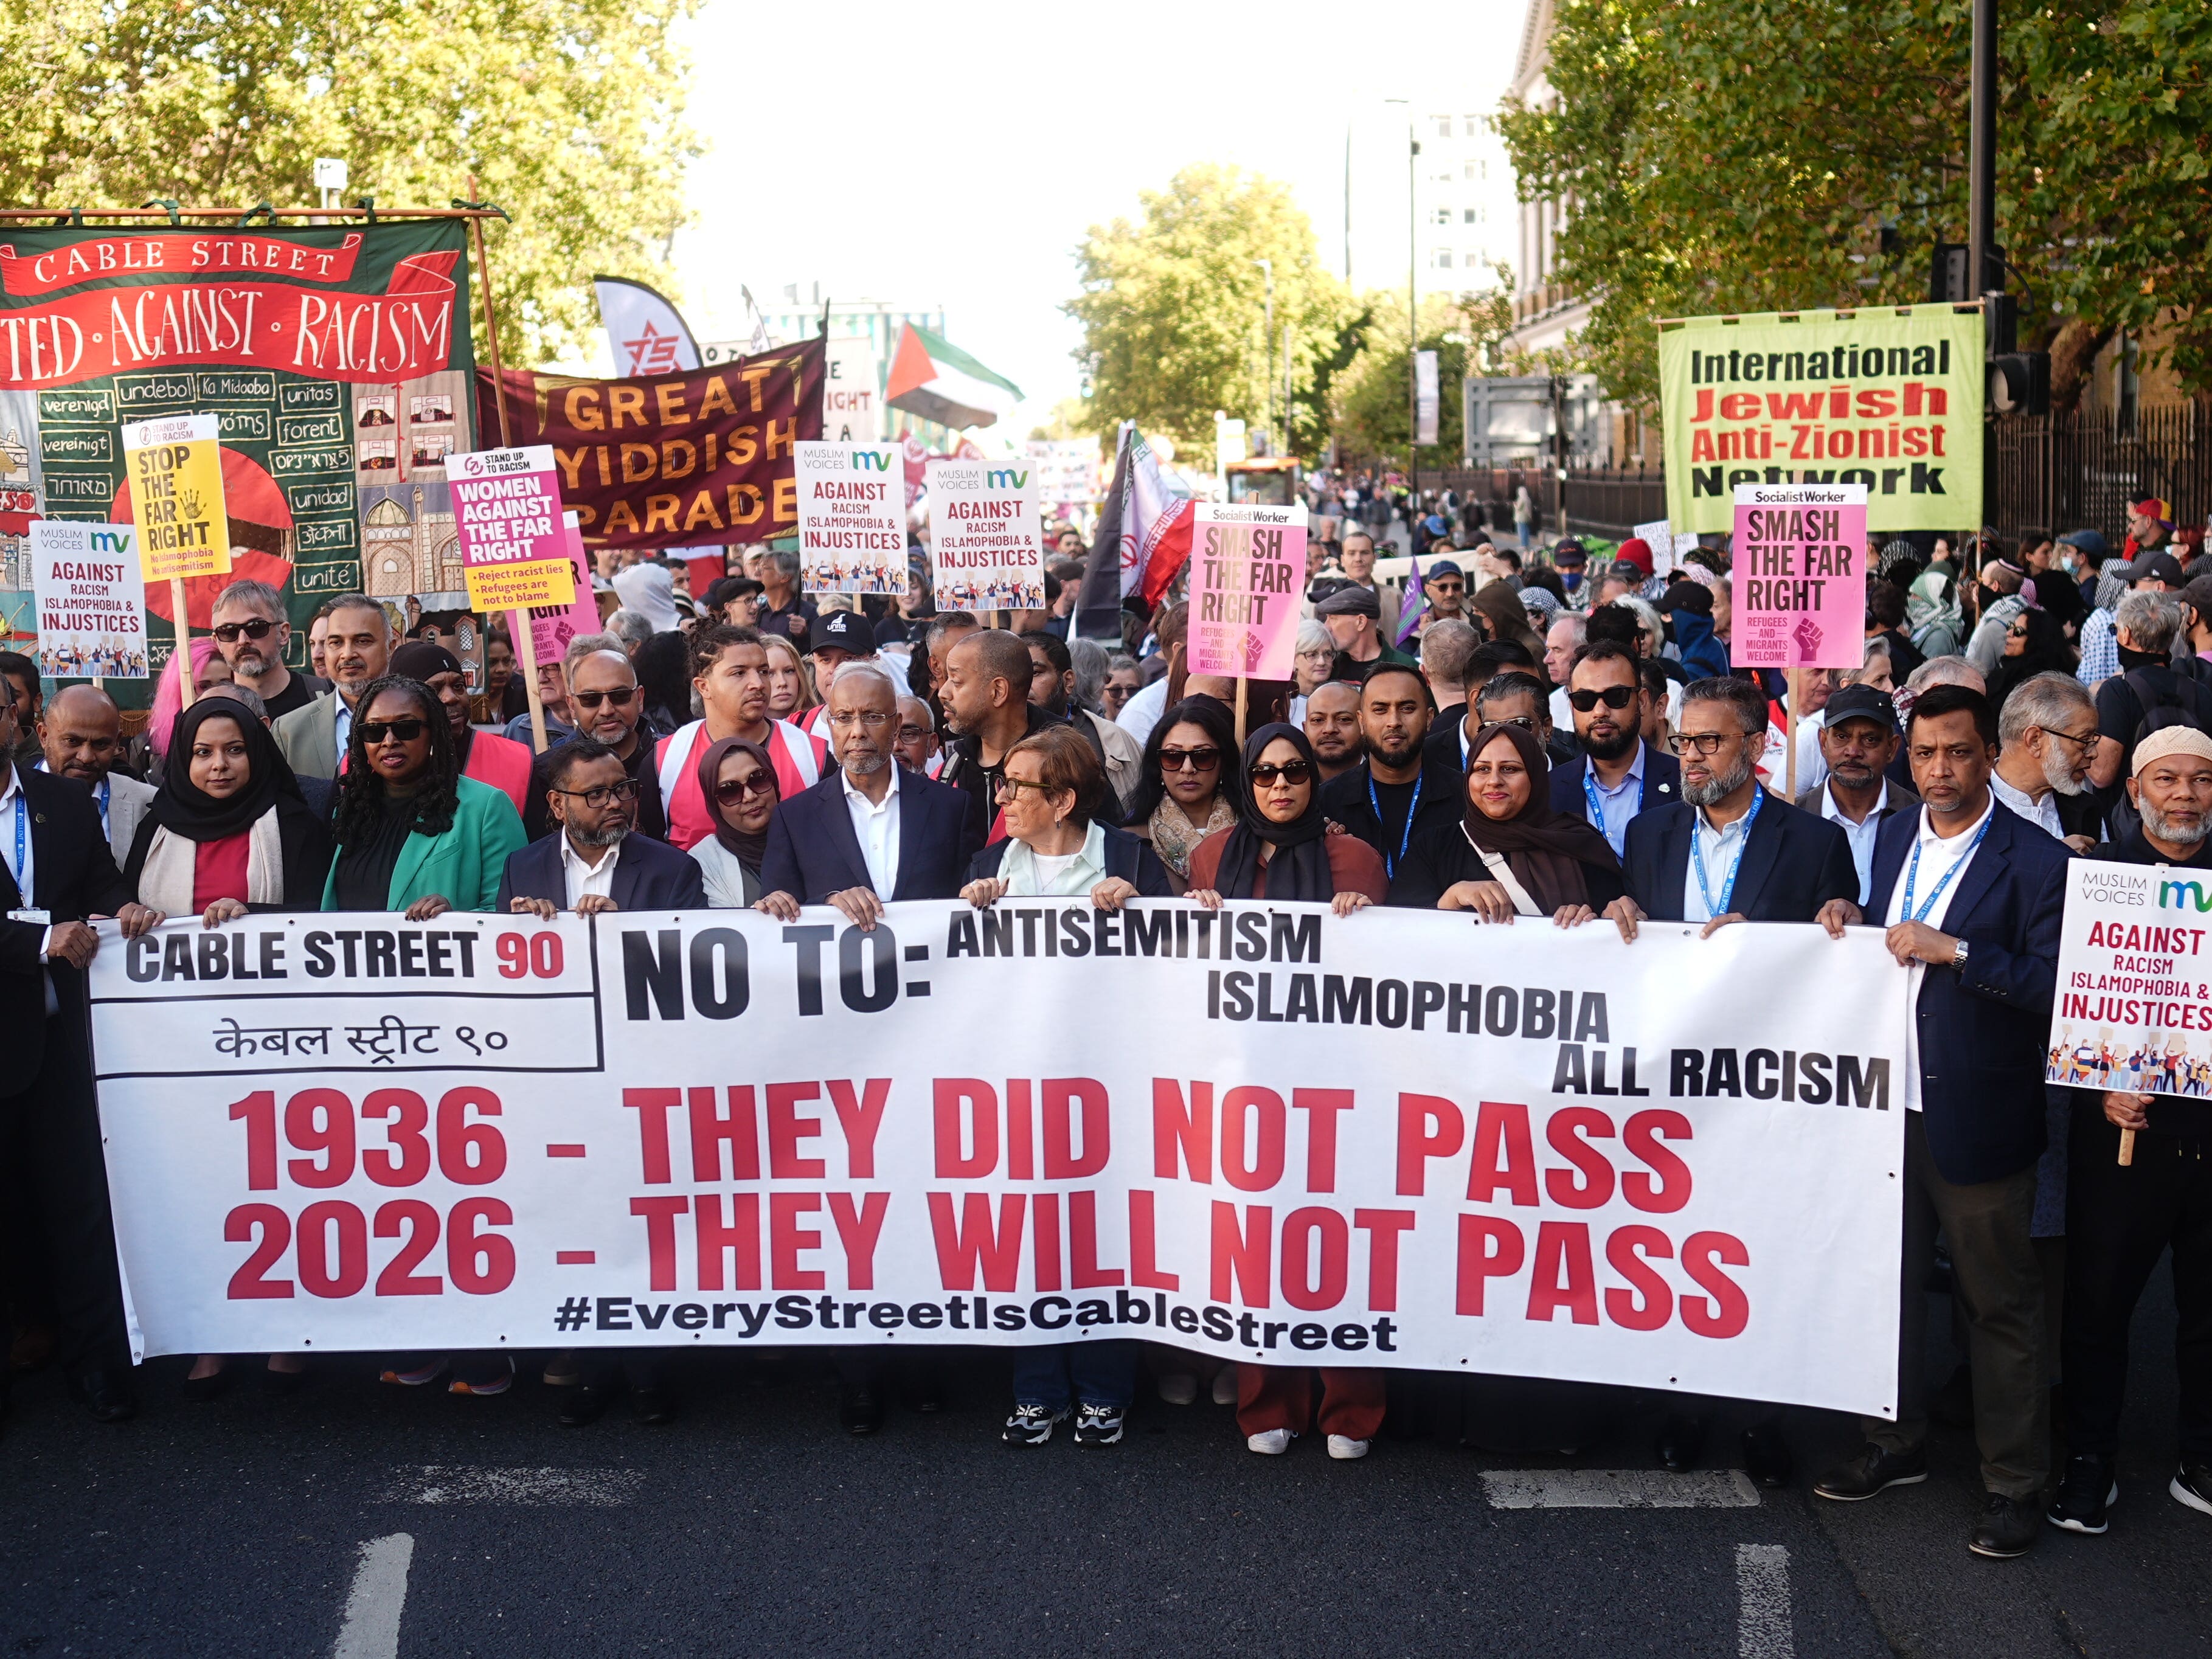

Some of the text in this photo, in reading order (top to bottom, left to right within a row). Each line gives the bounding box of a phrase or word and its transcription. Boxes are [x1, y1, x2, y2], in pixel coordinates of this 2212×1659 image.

[35, 241, 334, 283] CABLE STREET
[111, 288, 263, 366] AGAINST
[292, 294, 451, 373] RACISM
[1691, 339, 1950, 384] International
[203, 377, 216, 395] Ka
[287, 387, 333, 403] unitas
[44, 392, 109, 418] verenigd
[564, 369, 771, 431] GREAT
[1689, 382, 1947, 423] Jewish
[153, 421, 189, 434] STAND UP
[153, 431, 194, 442] TO RACISM
[282, 417, 339, 443] forent
[44, 436, 108, 457] vereinigt
[554, 417, 797, 489] YIDDISH
[1691, 422, 1947, 463] Anti-Zionist
[138, 446, 190, 474] STOP
[485, 452, 524, 464] STAND UP
[803, 449, 844, 459] MUSLIM
[803, 459, 844, 469] VOICES
[487, 462, 530, 474] TO RACISM
[937, 469, 979, 479] MUSLIM
[140, 473, 177, 500] THE
[457, 476, 541, 503] WOMEN
[813, 481, 887, 501] AGAINST
[937, 480, 979, 490] VOICES
[295, 486, 348, 509] unidad
[144, 499, 178, 526] FAR
[462, 496, 553, 523] AGAINST
[832, 503, 870, 514] RACISM
[947, 500, 1024, 520] AGAINST
[464, 516, 554, 543] THE FAR
[807, 516, 896, 529] ISLAMOPHOBIA &
[966, 521, 1007, 533] RACISM
[1747, 509, 1839, 542] SMASH
[40, 528, 83, 539] MUSLIM
[147, 521, 210, 551] RIGHT
[804, 531, 901, 550] INJUSTICES
[941, 535, 1033, 549] ISLAMOPHOBIA &
[1204, 526, 1283, 560] SMASH
[41, 539, 83, 550] VOICES
[468, 538, 534, 563] RIGHT
[150, 549, 213, 564] No Islamophobia
[938, 549, 1038, 569] INJUSTICES
[1746, 545, 1853, 577] THE FAR
[51, 562, 125, 582] AGAINST
[152, 561, 213, 575] No antisemitism
[302, 563, 351, 588] unité
[478, 570, 511, 584] Reject
[513, 566, 543, 578] racist
[546, 564, 564, 575] lies
[1202, 559, 1293, 594] THE FAR
[71, 584, 109, 596] RACISM
[480, 578, 548, 596] Refugees are
[1747, 580, 1826, 611] RIGHT
[45, 597, 134, 612] ISLAMOPHOBIA &
[483, 591, 550, 606] not to blame
[1201, 592, 1269, 625] RIGHT
[42, 613, 139, 633] INJUSTICES
[1201, 627, 1235, 638] REFUGEES
[1747, 617, 1788, 628] REFUGEES
[1758, 628, 1775, 638] AND
[1199, 648, 1235, 660] MIGRANTS
[1210, 640, 1225, 649] AND
[1746, 640, 1788, 650] MIGRANTS
[1199, 659, 1233, 671] WELCOME
[1747, 651, 1787, 662] WELCOME
[2082, 872, 2147, 890] MUSLIM
[1719, 882, 1732, 915] TOGETHER
[1915, 877, 1947, 923] OGETHER OPEN
[2082, 887, 2144, 906] VOICES
[946, 907, 1322, 965] ANTISEMITISM
[2087, 920, 2206, 955] AGAINST
[125, 930, 564, 983] CABLE STREET 90
[2113, 954, 2174, 975] RACISM
[621, 922, 931, 1021] NO TO:
[2071, 971, 2210, 1000] ISLAMOPHOBIA &
[1207, 969, 1610, 1044] ISLAMOPHOBIA
[2061, 993, 2212, 1032] INJUSTICES
[213, 1014, 508, 1064] केबल स्ट्रीट ९०
[1551, 1043, 1891, 1112] ALL RACISM
[228, 1086, 508, 1191] 1936
[622, 1077, 893, 1185] THEY
[932, 1076, 1111, 1182] DID
[1151, 1076, 1355, 1195] NOT
[1395, 1091, 1694, 1215] PASS
[223, 1196, 516, 1301] 2026
[629, 1191, 892, 1292] THEY
[925, 1188, 1180, 1294] WILL
[1209, 1198, 1416, 1313] NOT
[1455, 1211, 1750, 1339] PASS
[553, 1289, 1398, 1352] #EveryStreetIsCableStreet
